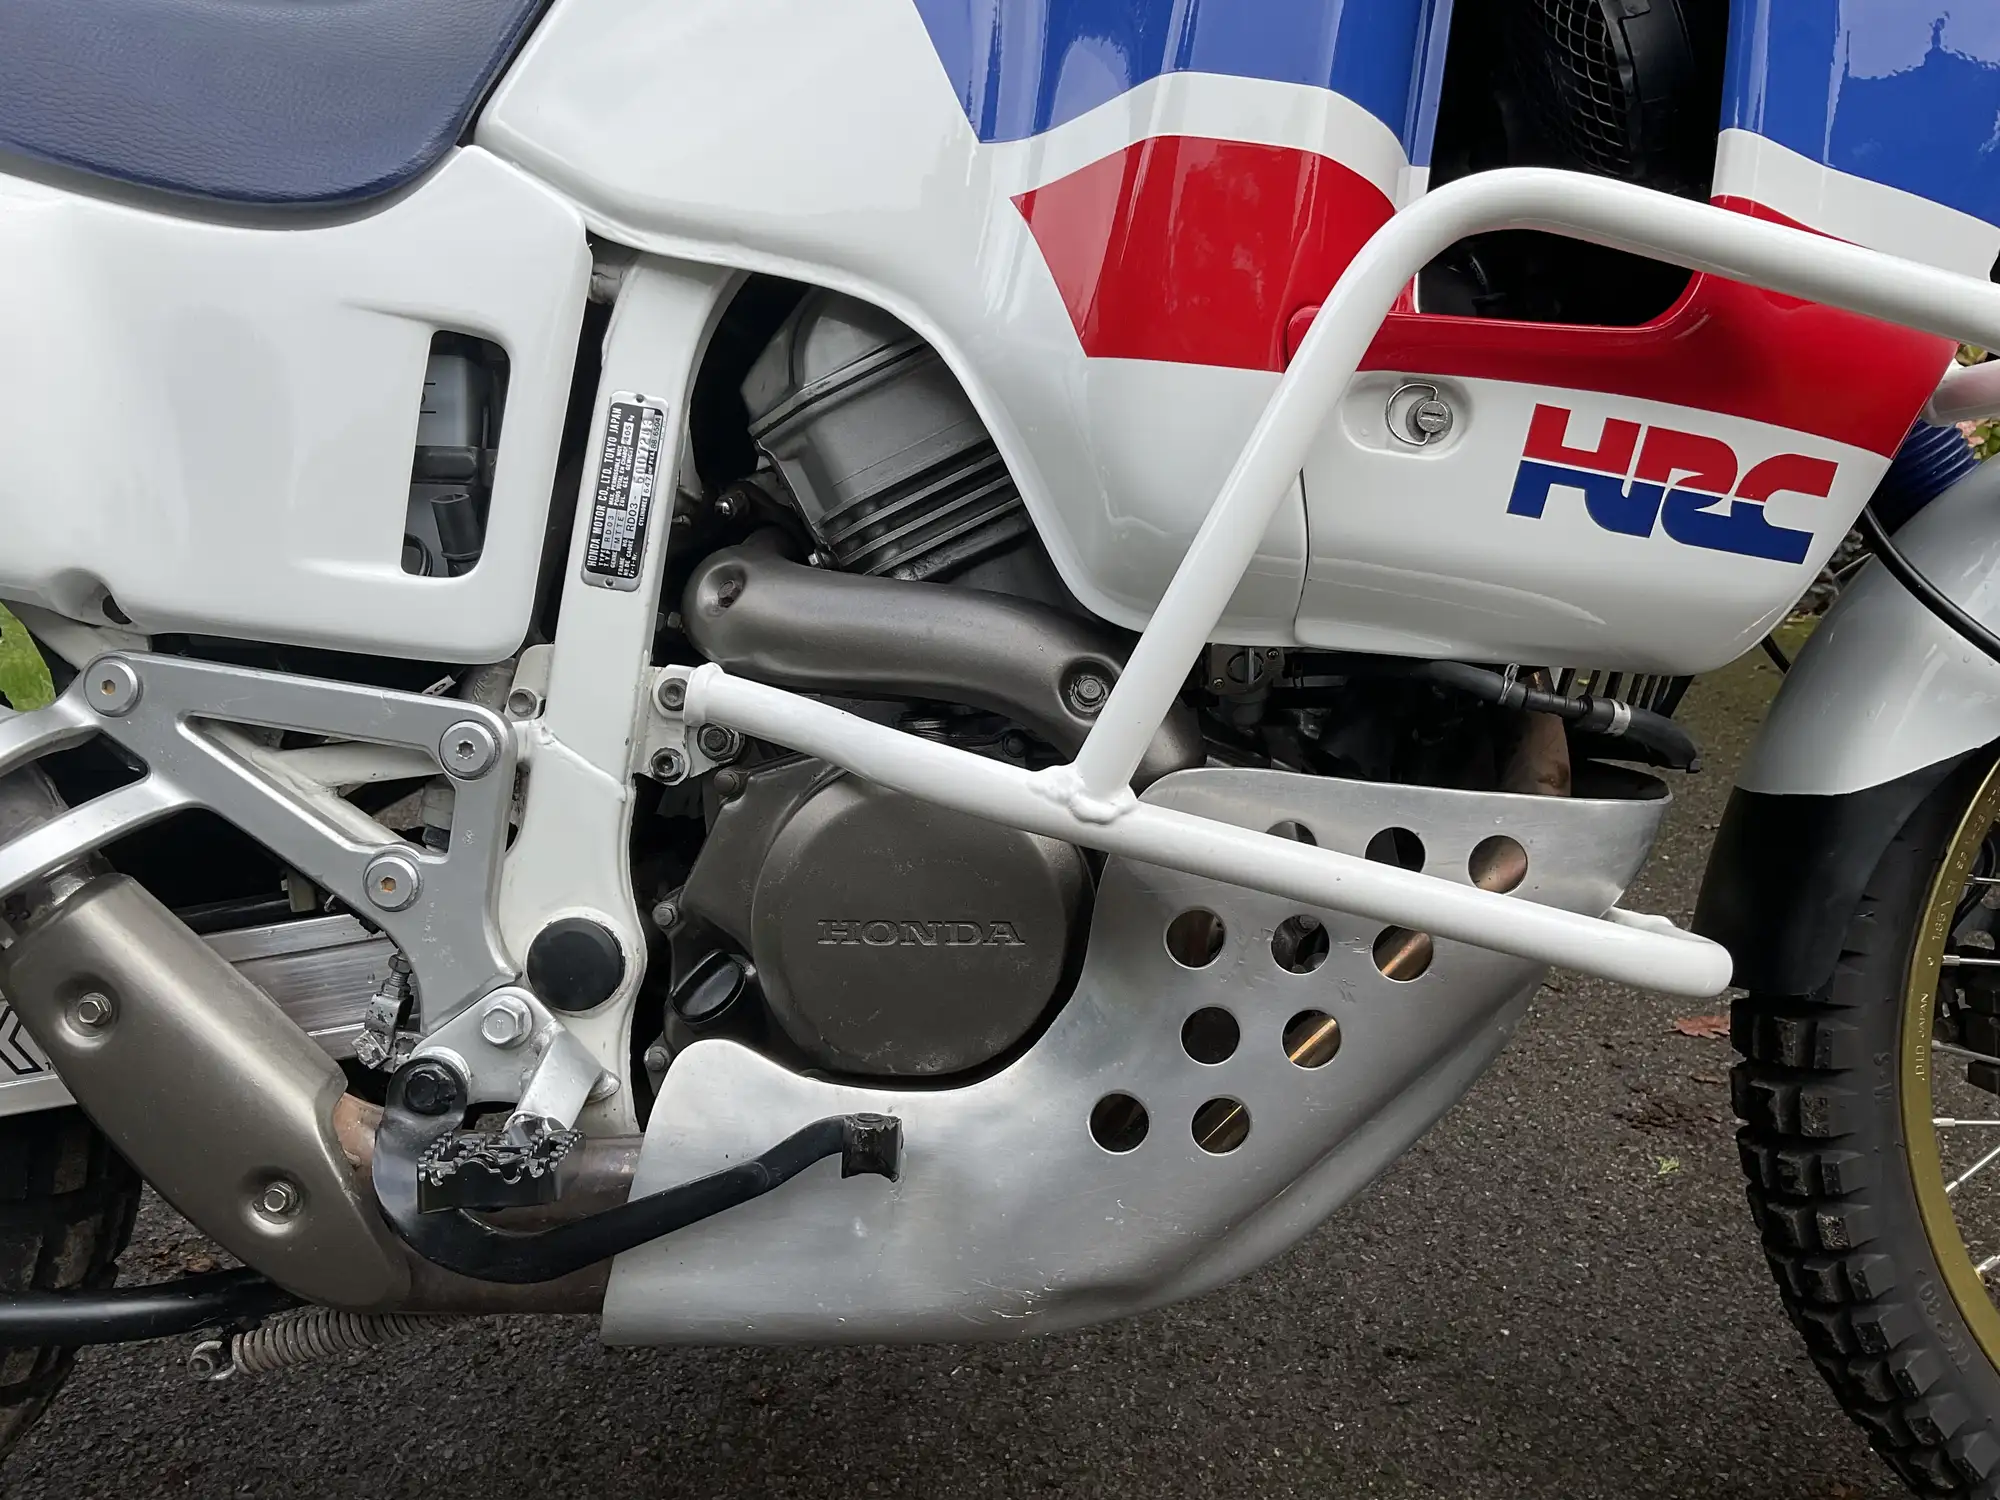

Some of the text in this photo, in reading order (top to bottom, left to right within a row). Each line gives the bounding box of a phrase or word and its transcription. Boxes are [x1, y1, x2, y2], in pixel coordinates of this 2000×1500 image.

[609, 407, 622, 433] JAPAN
[604, 435, 617, 463] TOKYO
[601, 464, 612, 484] LTD.
[1506, 403, 1839, 564] HRC
[592, 504, 606, 534] MOTOR
[587, 537, 600, 566] HONDA
[817, 919, 1026, 946] HONDA
